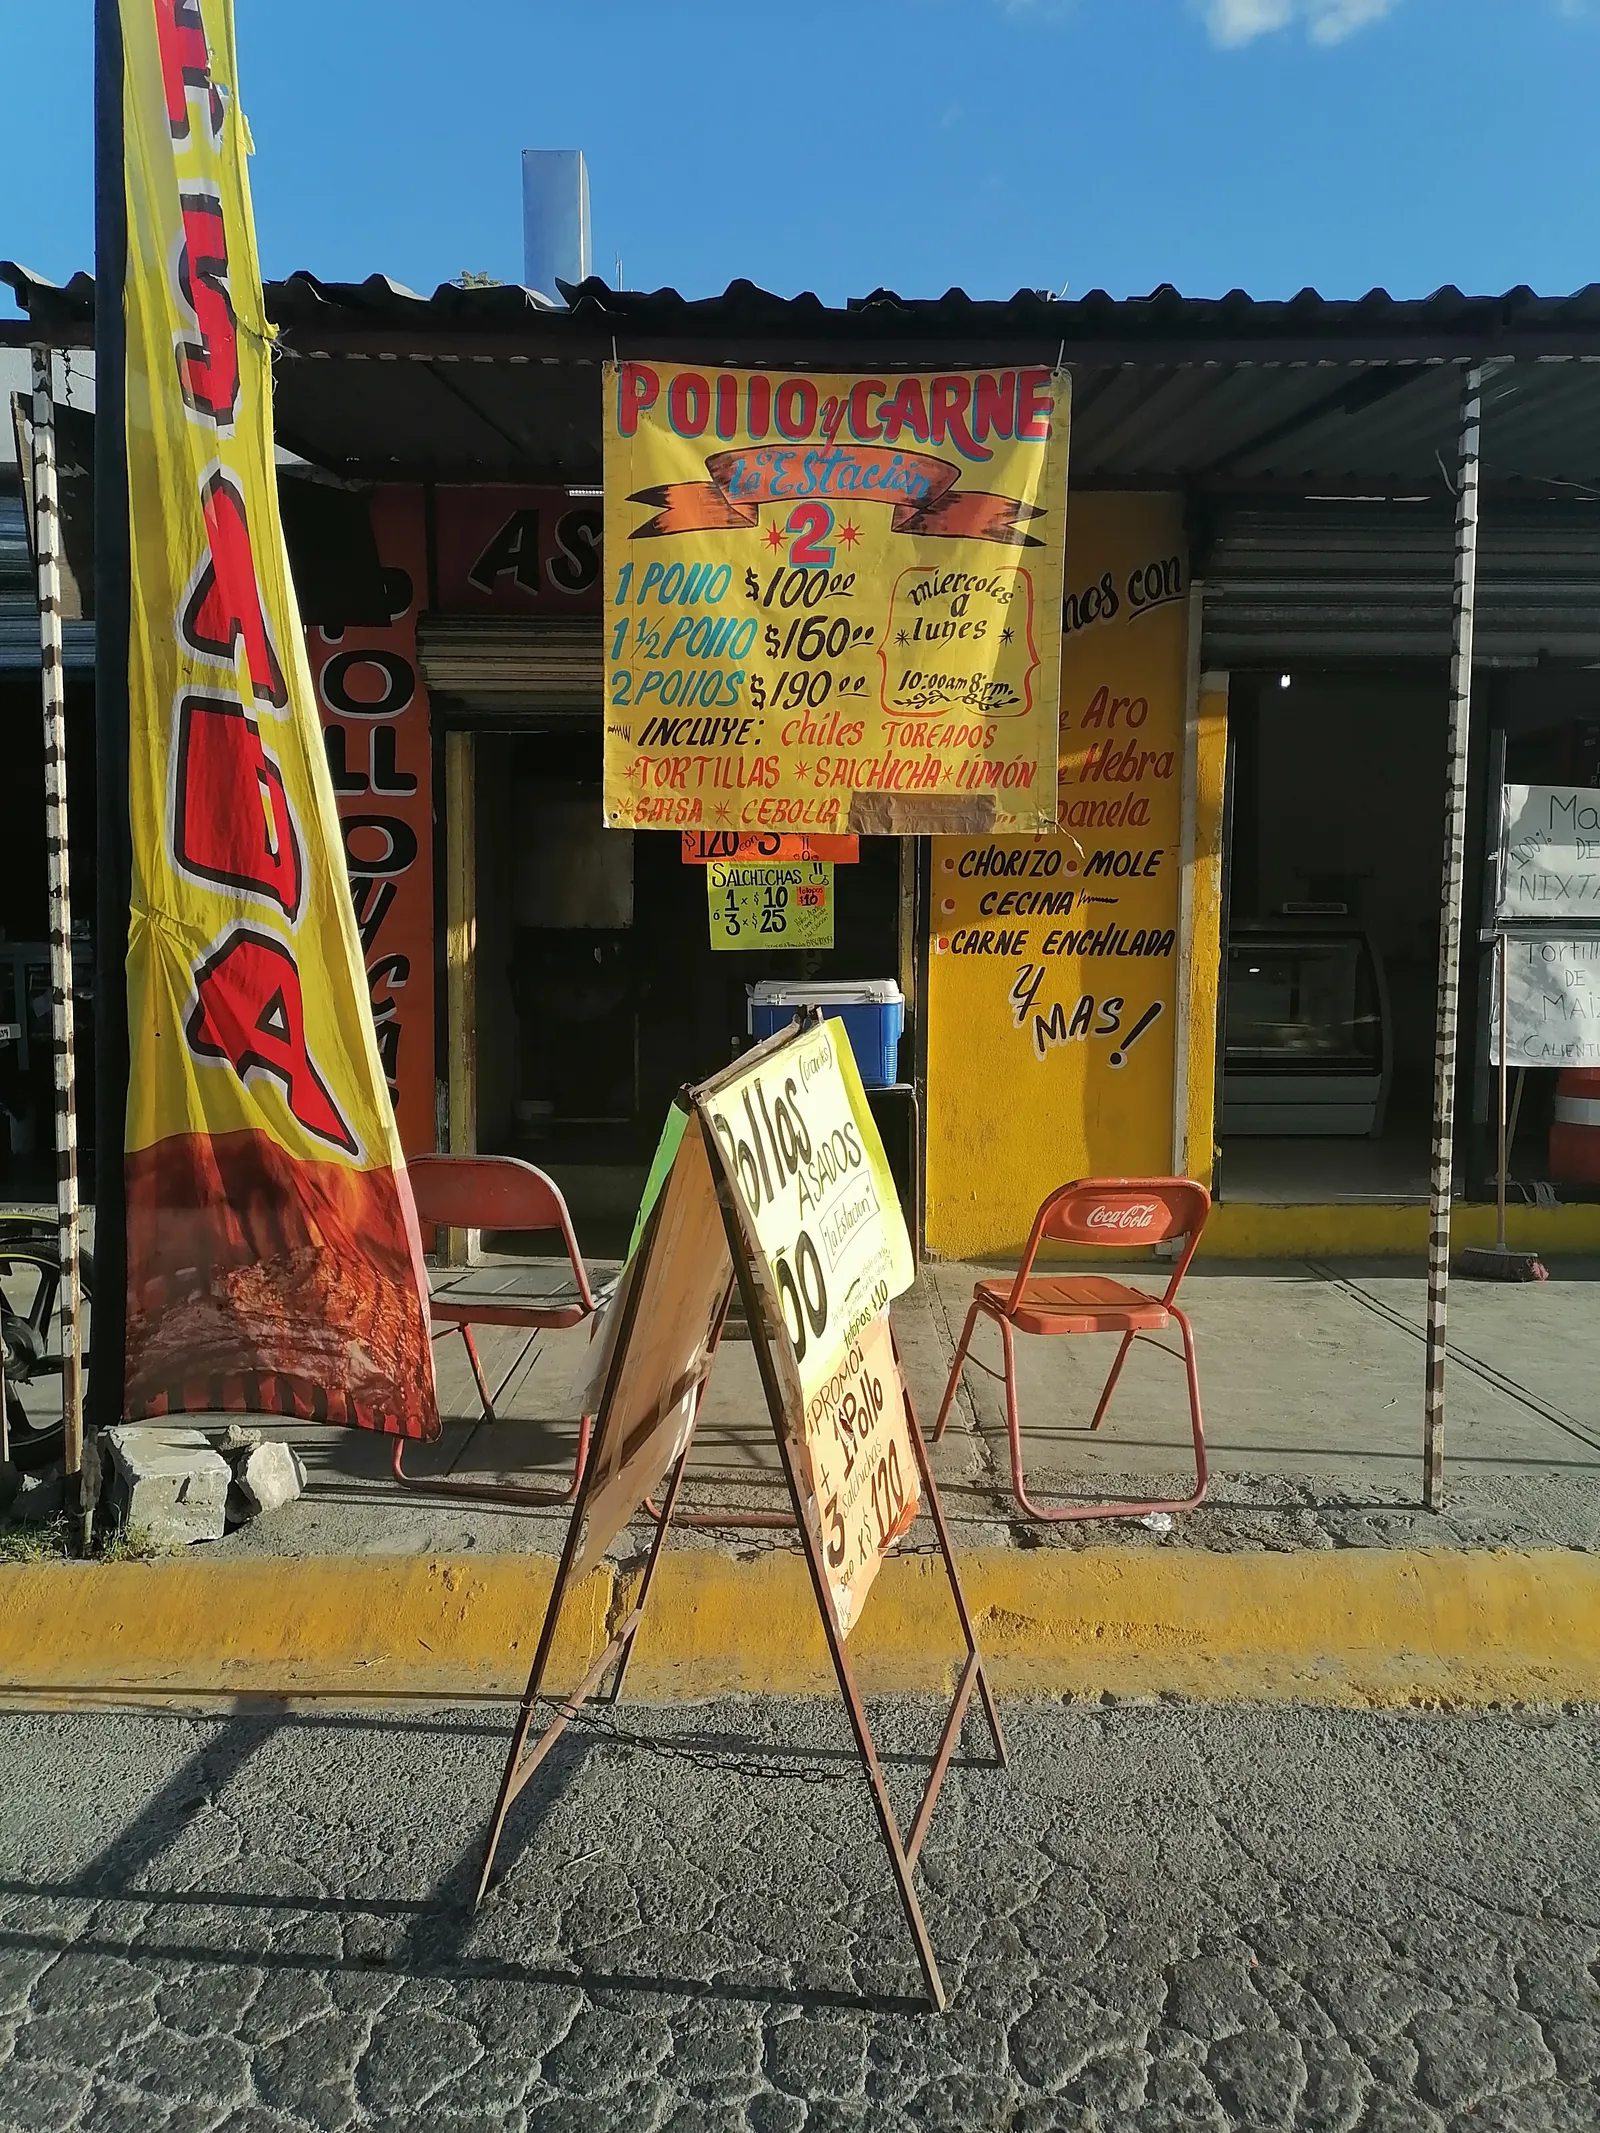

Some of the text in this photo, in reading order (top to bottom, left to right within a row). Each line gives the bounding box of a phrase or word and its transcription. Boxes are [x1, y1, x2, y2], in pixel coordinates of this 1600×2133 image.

[847, 369, 1056, 462] CARNE
[468, 509, 604, 595] AS
[784, 500, 837, 570] 2
[614, 562, 634, 606] 1
[907, 570, 1014, 606] miercoles
[1127, 556, 1182, 606] con
[950, 593, 970, 618] a
[611, 670, 633, 706] 2
[1080, 686, 1149, 729] Aro
[637, 716, 765, 747] INCLUYE:
[881, 721, 998, 750] TOREADOS
[634, 755, 781, 789] TORTILLAS
[1079, 738, 1175, 783] Hebra
[958, 844, 1164, 877] CHORIZO MOLE
[1510, 828, 1552, 870] 100%
[711, 862, 802, 888] SALCHICHAS
[979, 891, 1075, 915] CECINA
[724, 913, 741, 936] 3
[951, 922, 1176, 957] CARNE ENCHILADA
[1565, 969, 1585, 987] DE
[798, 1121, 861, 1222] ASADOS
[824, 1492, 846, 1569] 3
